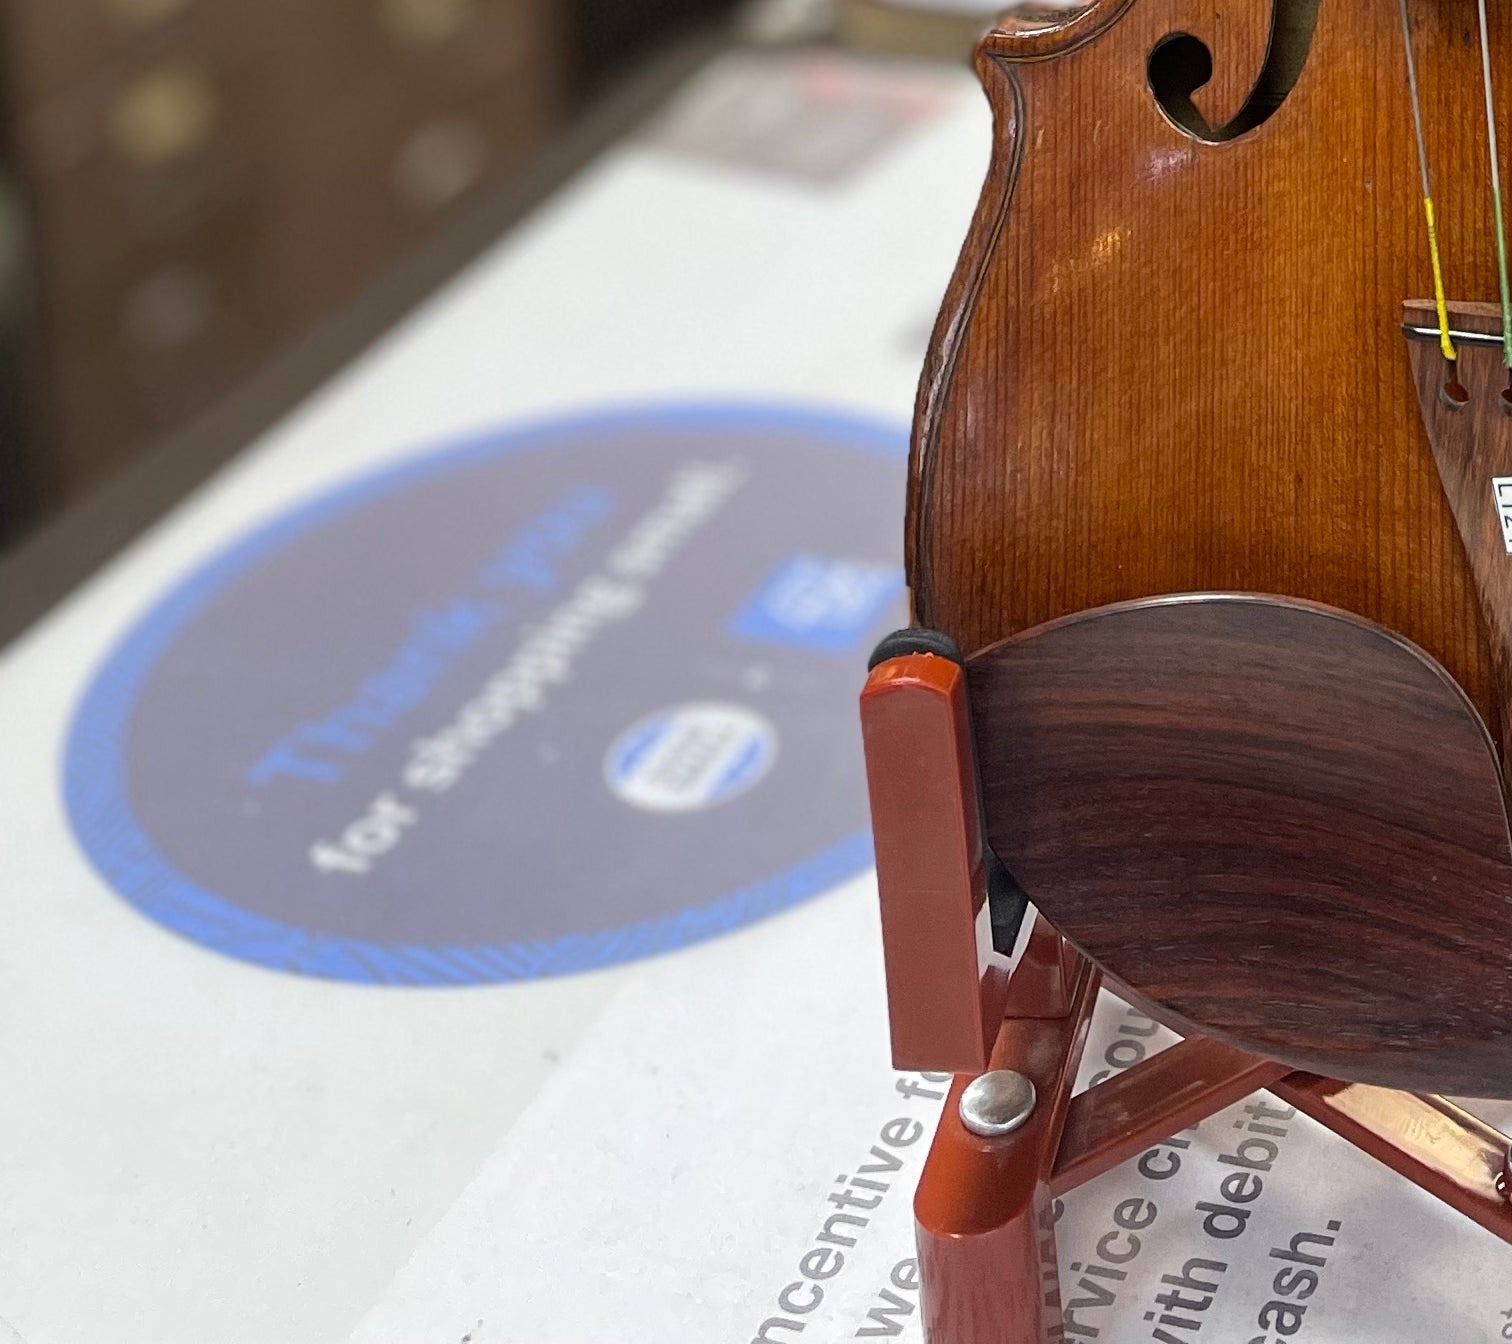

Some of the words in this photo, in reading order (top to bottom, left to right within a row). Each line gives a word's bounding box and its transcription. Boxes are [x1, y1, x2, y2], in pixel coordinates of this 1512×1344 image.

[309, 792, 419, 876] for
[404, 574, 643, 792] shopping
[1195, 1101, 1296, 1239] debit
